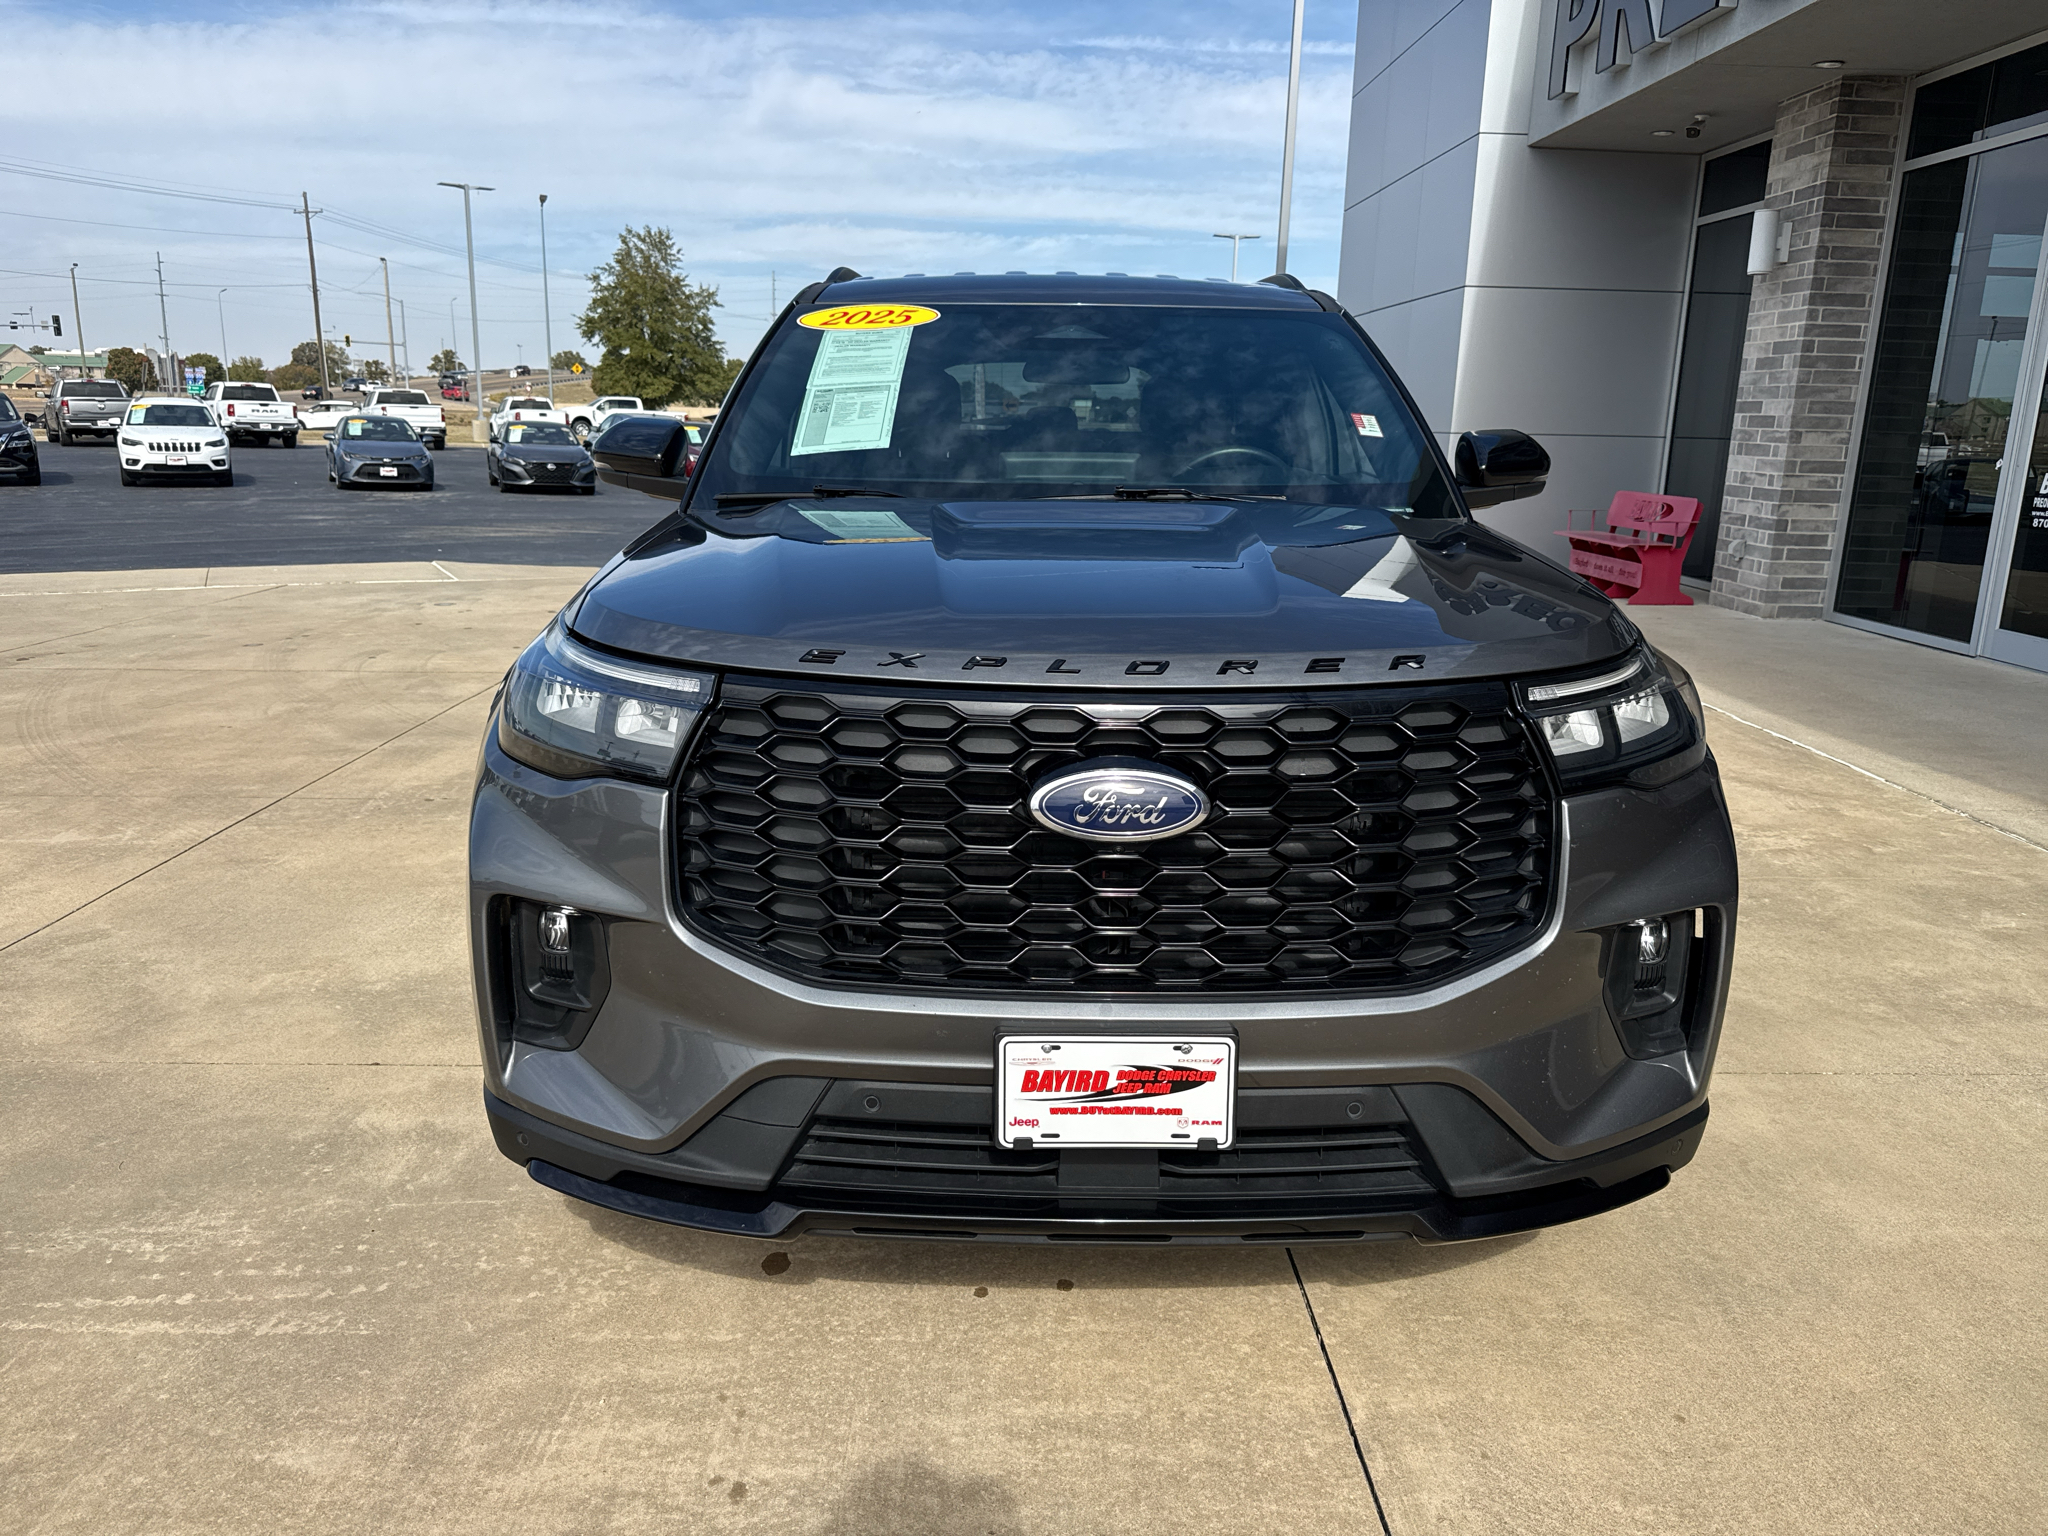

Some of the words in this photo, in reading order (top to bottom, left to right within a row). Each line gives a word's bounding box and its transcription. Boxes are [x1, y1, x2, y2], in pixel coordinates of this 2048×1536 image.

[819, 309, 919, 326] 2025
[798, 648, 1428, 676] EXPLORER
[1073, 783, 1168, 824] Ford
[1020, 1069, 1110, 1092] BAYIRD
[1115, 1070, 1156, 1081] DODGE
[1157, 1070, 1217, 1082] CHRYSLER
[1112, 1082, 1142, 1093] JEEP
[1142, 1083, 1172, 1093] RAM
[1049, 1106, 1183, 1115] www.BUYatBAYIRD.com
[1009, 1116, 1039, 1128] Jeep
